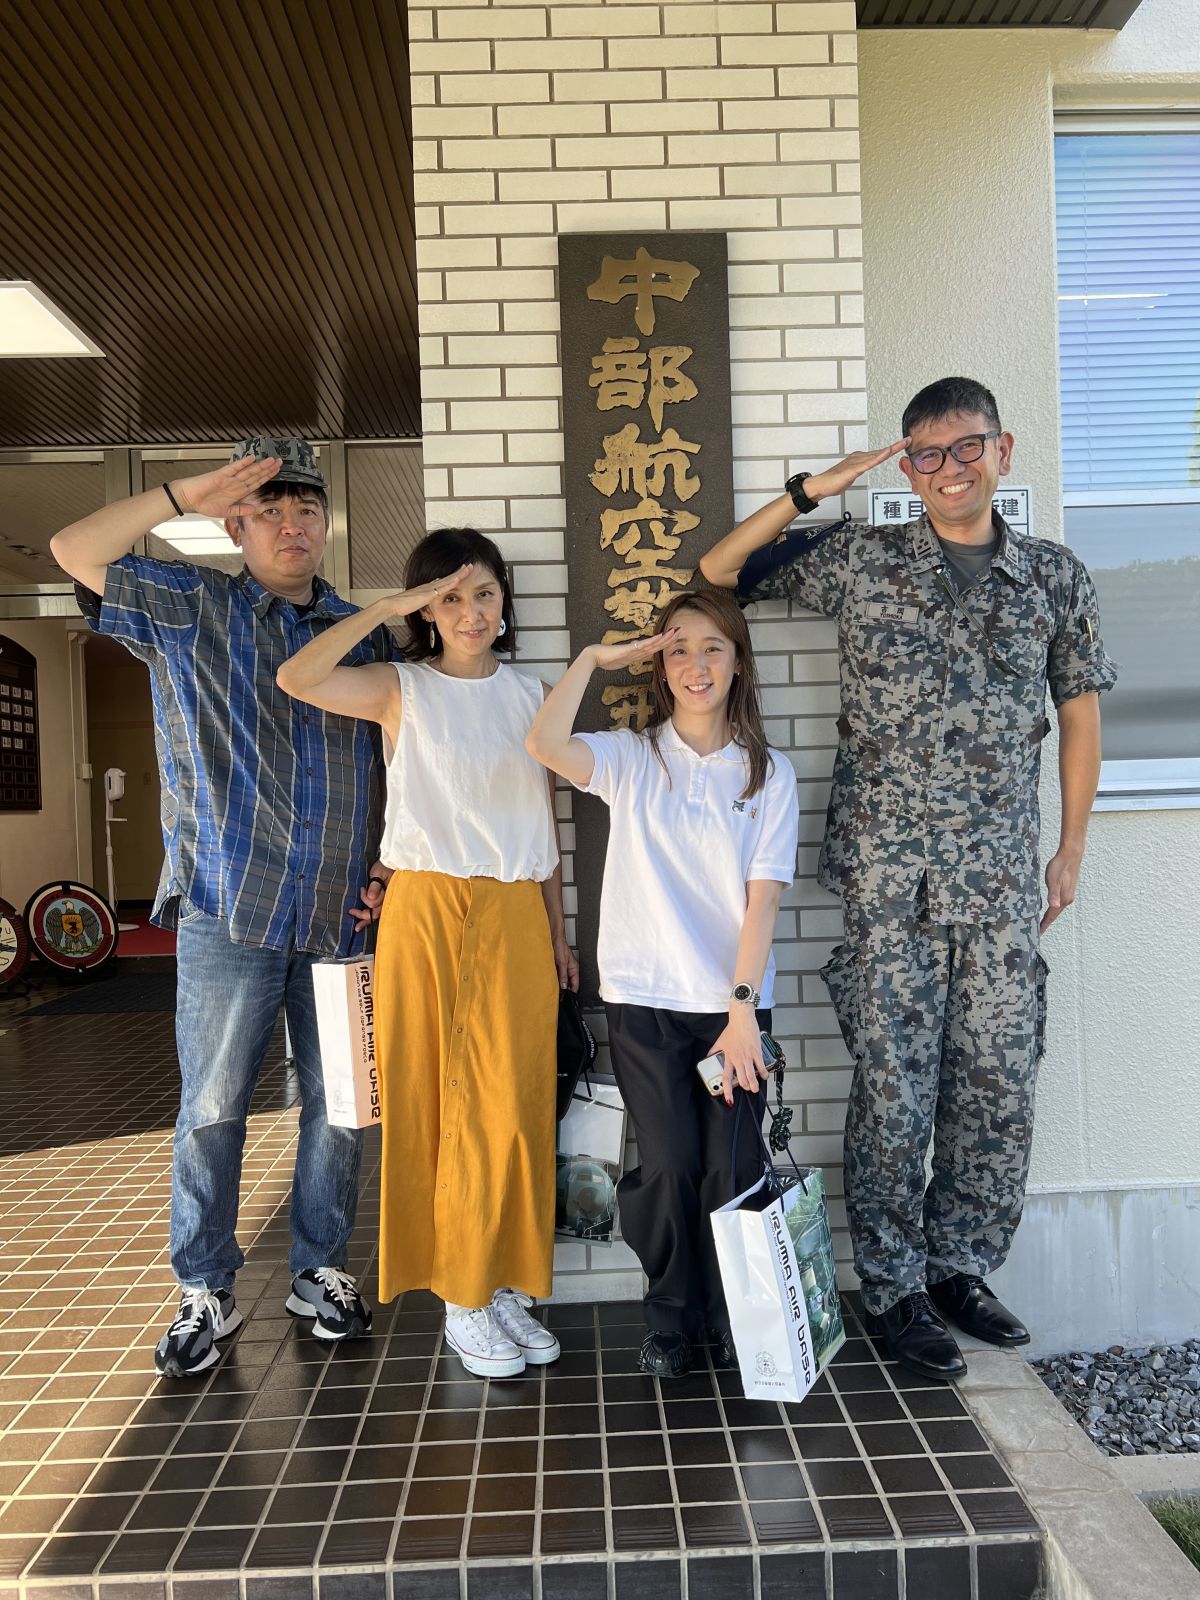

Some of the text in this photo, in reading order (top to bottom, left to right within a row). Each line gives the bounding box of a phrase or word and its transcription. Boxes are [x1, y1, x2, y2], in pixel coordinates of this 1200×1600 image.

[360, 966, 374, 1026] IRUMA
[771, 1211, 792, 1280] IRUMA
[788, 1286, 801, 1321] AIR
